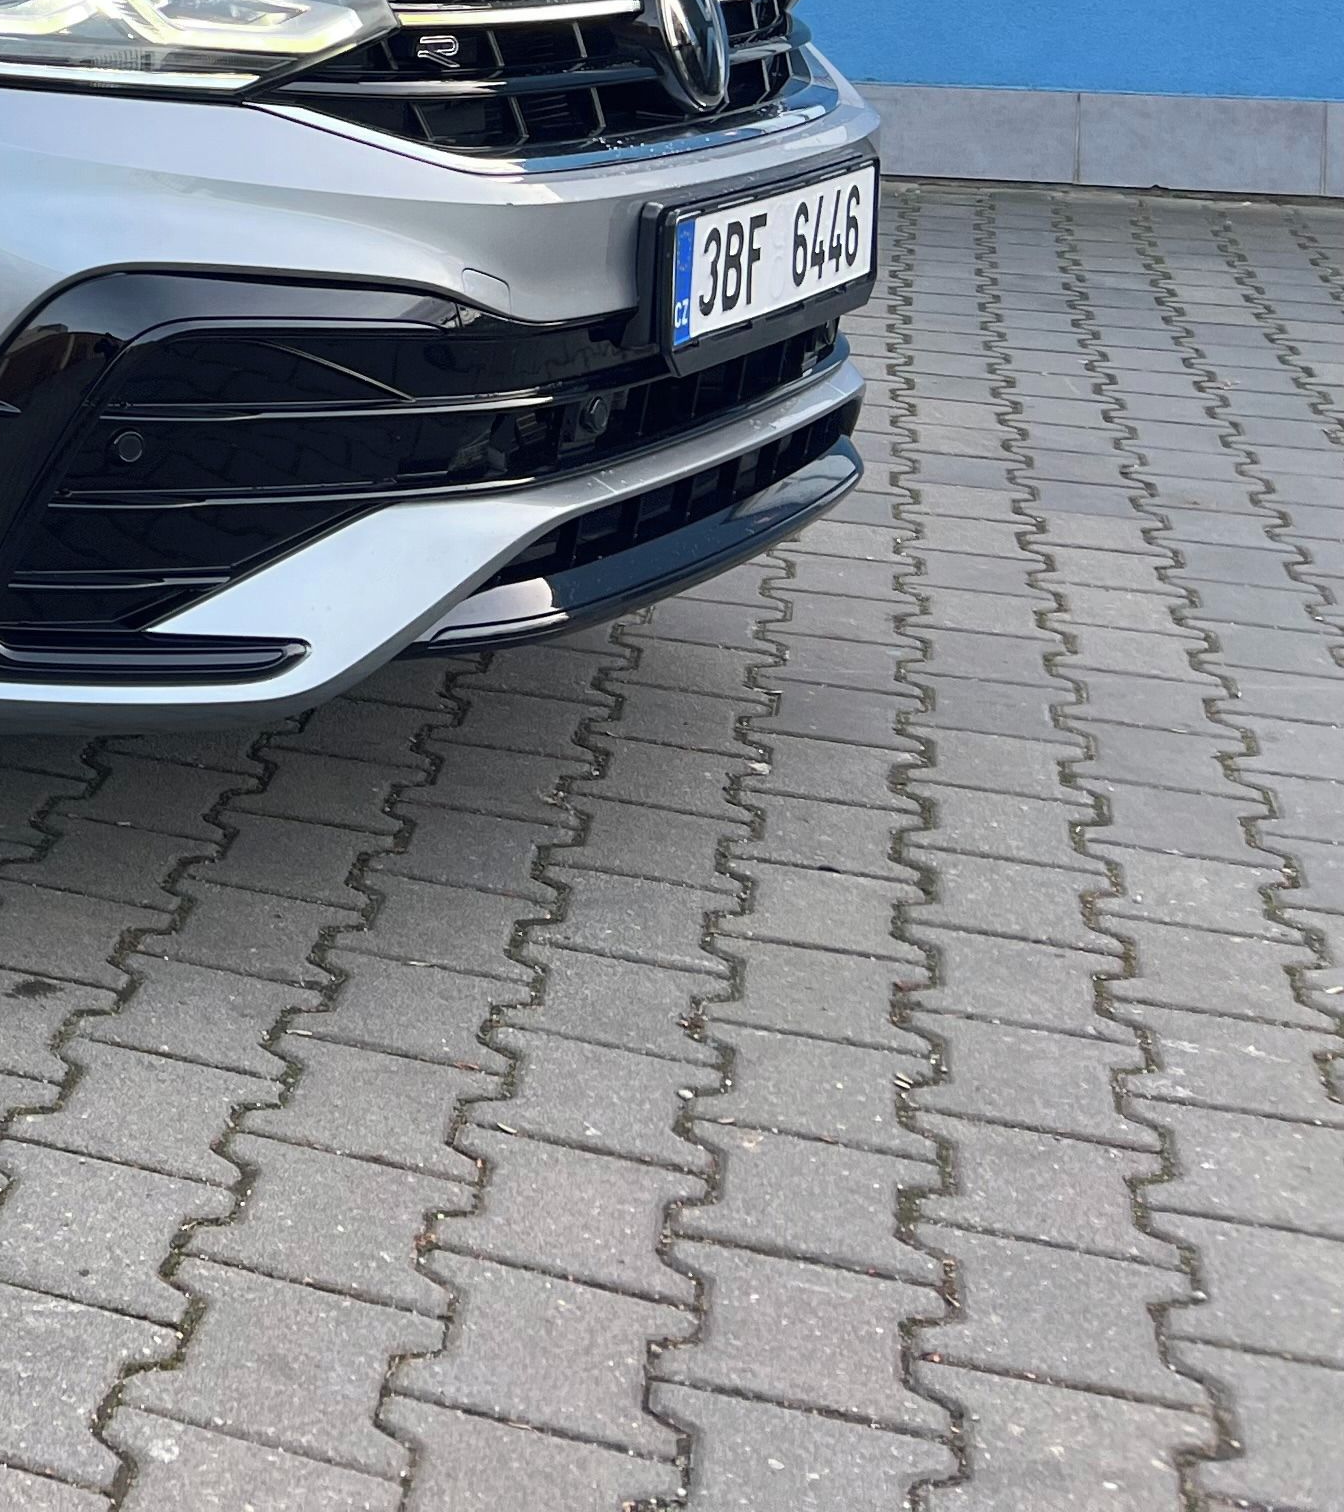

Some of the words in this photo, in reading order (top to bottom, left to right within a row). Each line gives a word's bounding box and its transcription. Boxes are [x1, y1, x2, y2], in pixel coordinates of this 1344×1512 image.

[698, 213, 768, 317] 3BF
[792, 184, 860, 288] 6446
[674, 297, 690, 329] CZ
